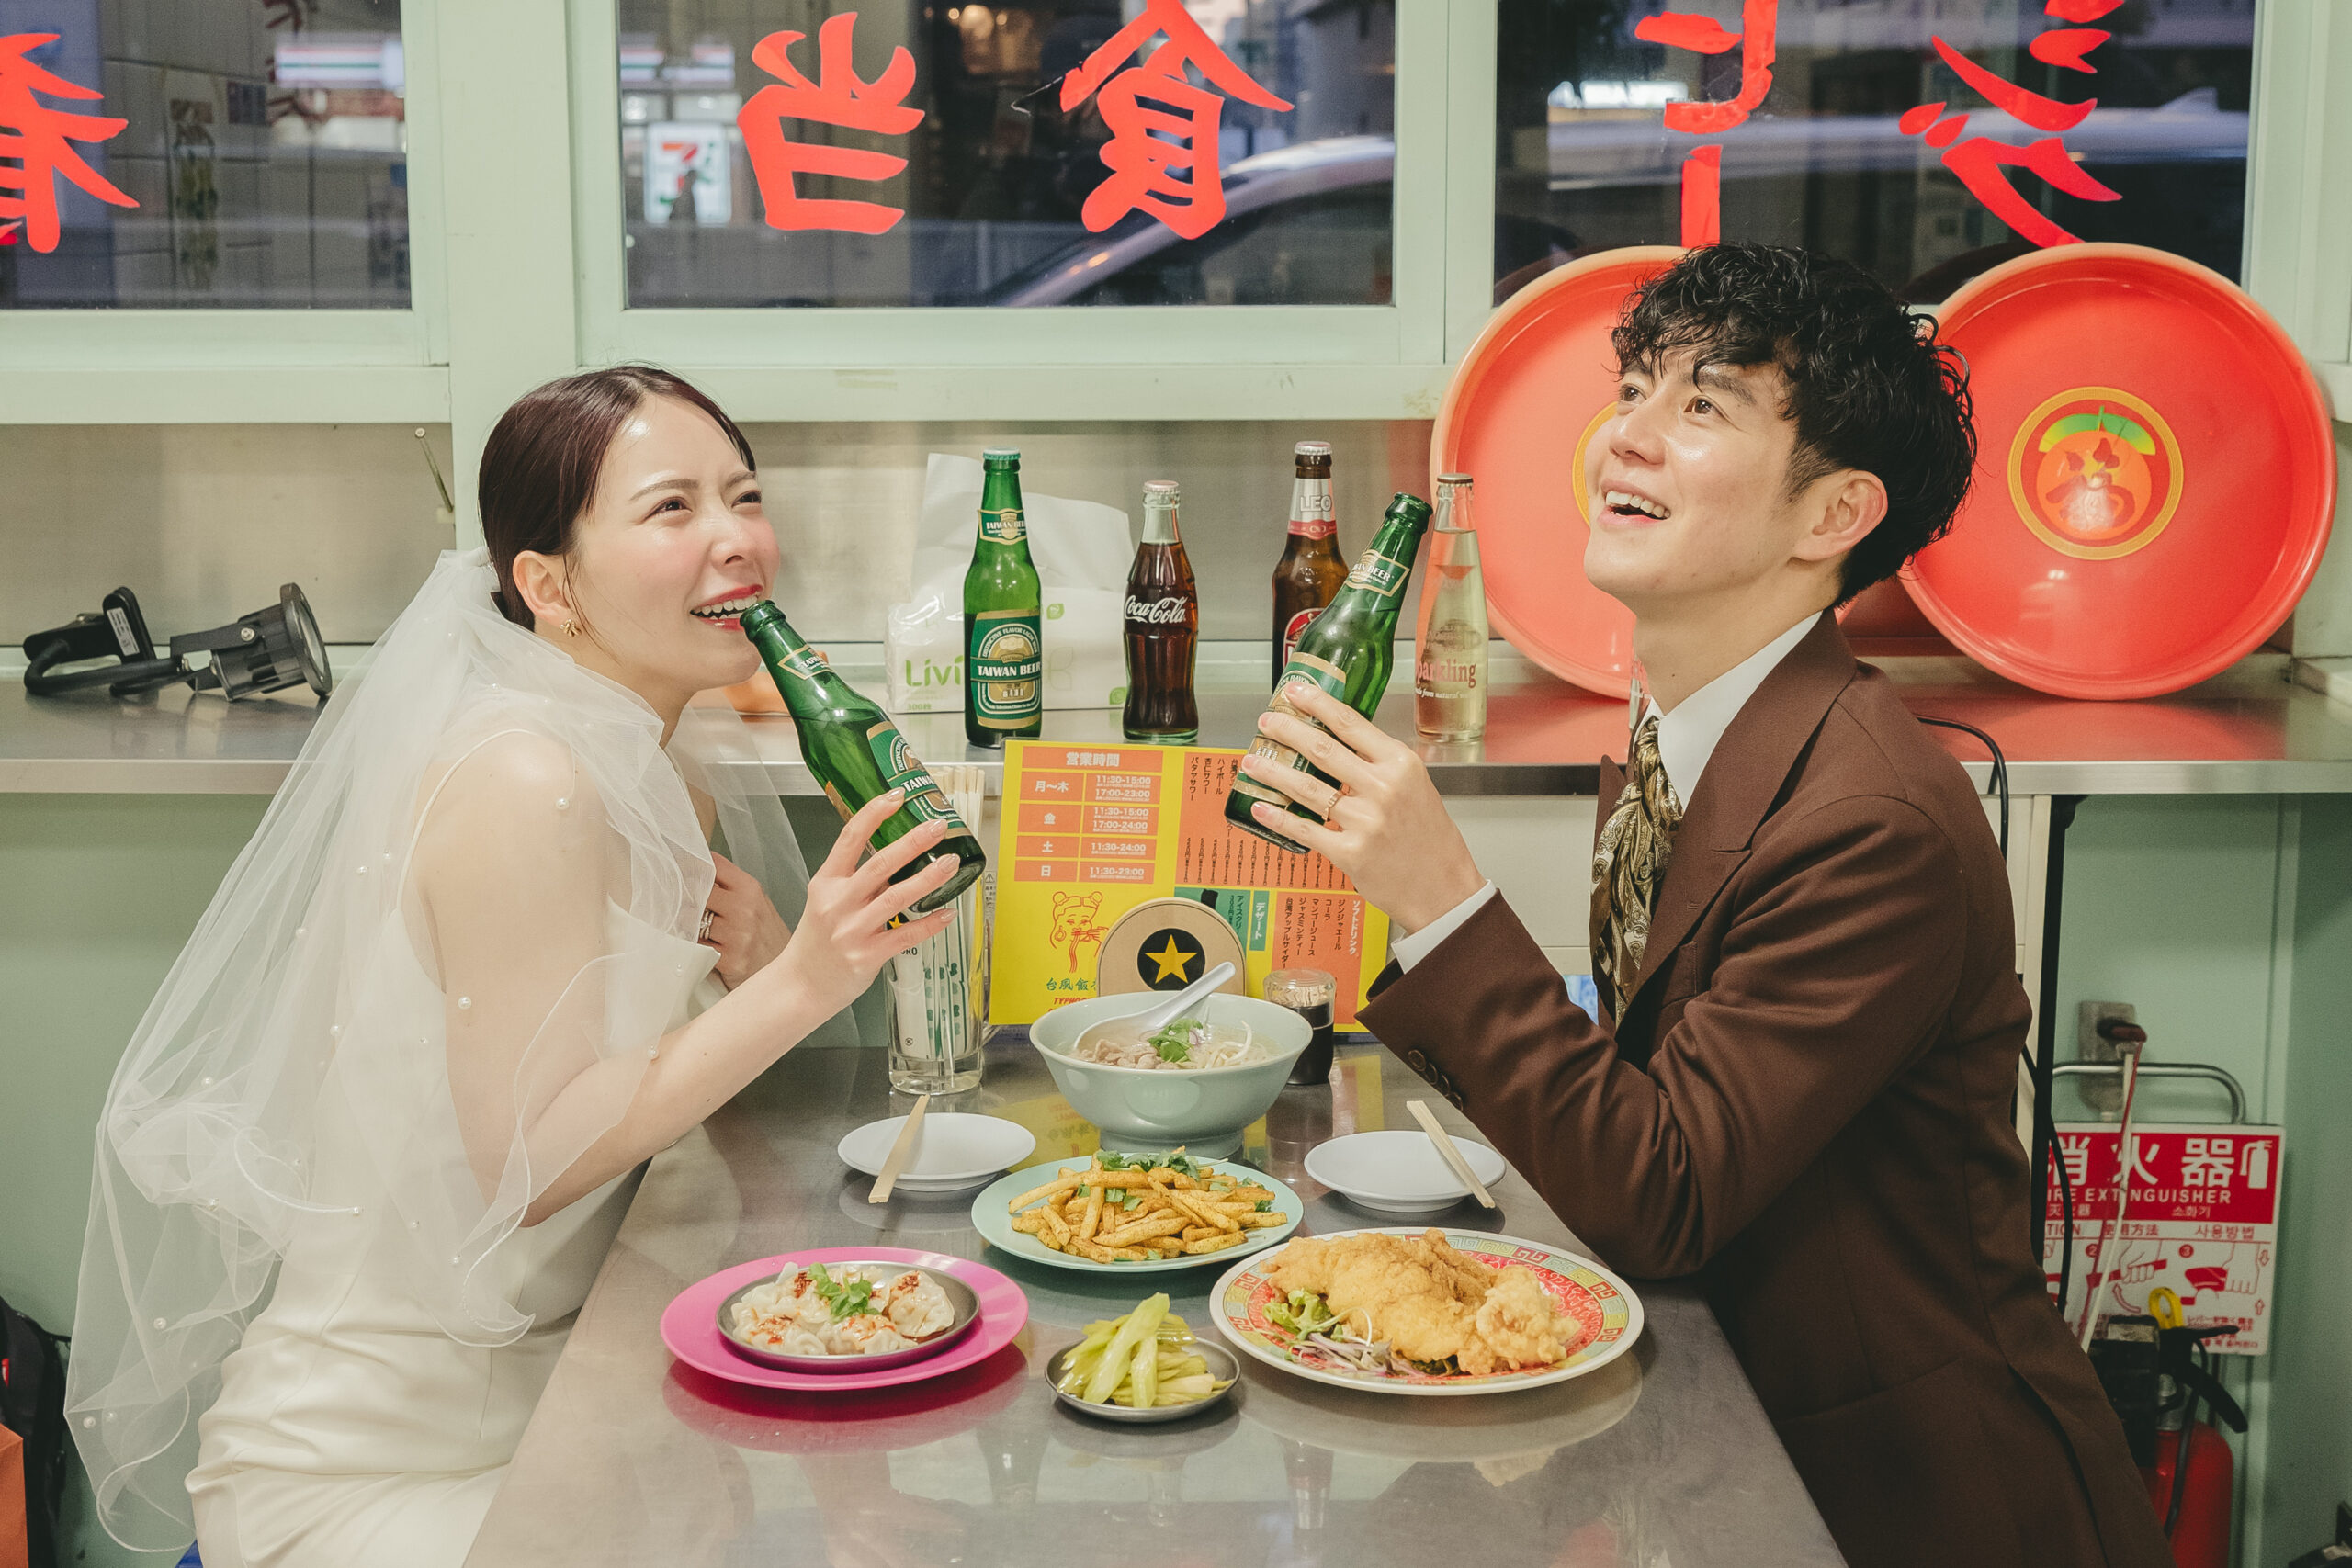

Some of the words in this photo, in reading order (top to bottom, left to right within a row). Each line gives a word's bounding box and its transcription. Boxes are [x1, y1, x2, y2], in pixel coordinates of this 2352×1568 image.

[1300, 495, 1332, 512] LEO
[1367, 565, 1391, 582] BEER
[1125, 594, 1188, 624] Coca-Cola
[977, 664, 1017, 677] TAIWAN
[1019, 660, 1041, 676] BEER
[1416, 657, 1476, 689] parkling
[1066, 751, 1121, 768] 営業時間
[900, 774, 935, 793] TAIWA
[1095, 774, 1152, 785] 11:30-15:00
[1215, 758, 1226, 795] ハイボール
[1094, 788, 1151, 798] 17:00-23:00
[1043, 812, 1057, 826] 金
[1094, 807, 1149, 817] 11:30-15:00
[1092, 820, 1148, 830] 17:00-24:00
[1041, 840, 1054, 853] 土
[1091, 841, 1148, 852] 11:30-24:00
[1040, 865, 1052, 878] 日
[1089, 866, 1146, 876] 11:30-23:00
[1235, 895, 1245, 936] アイスクリー
[1324, 899, 1333, 921] コーラ
[1254, 902, 1266, 940] デザート
[1296, 897, 1307, 956] ジャスミンティー
[1308, 898, 1320, 956] マンゴージュース
[1334, 899, 1346, 951] ジンジャエール
[1348, 899, 1362, 955] ソフトドリンク
[1282, 897, 1294, 969] 台湾アップルサイダー
[2085, 1188, 2231, 1204] EXTNGUISHER
